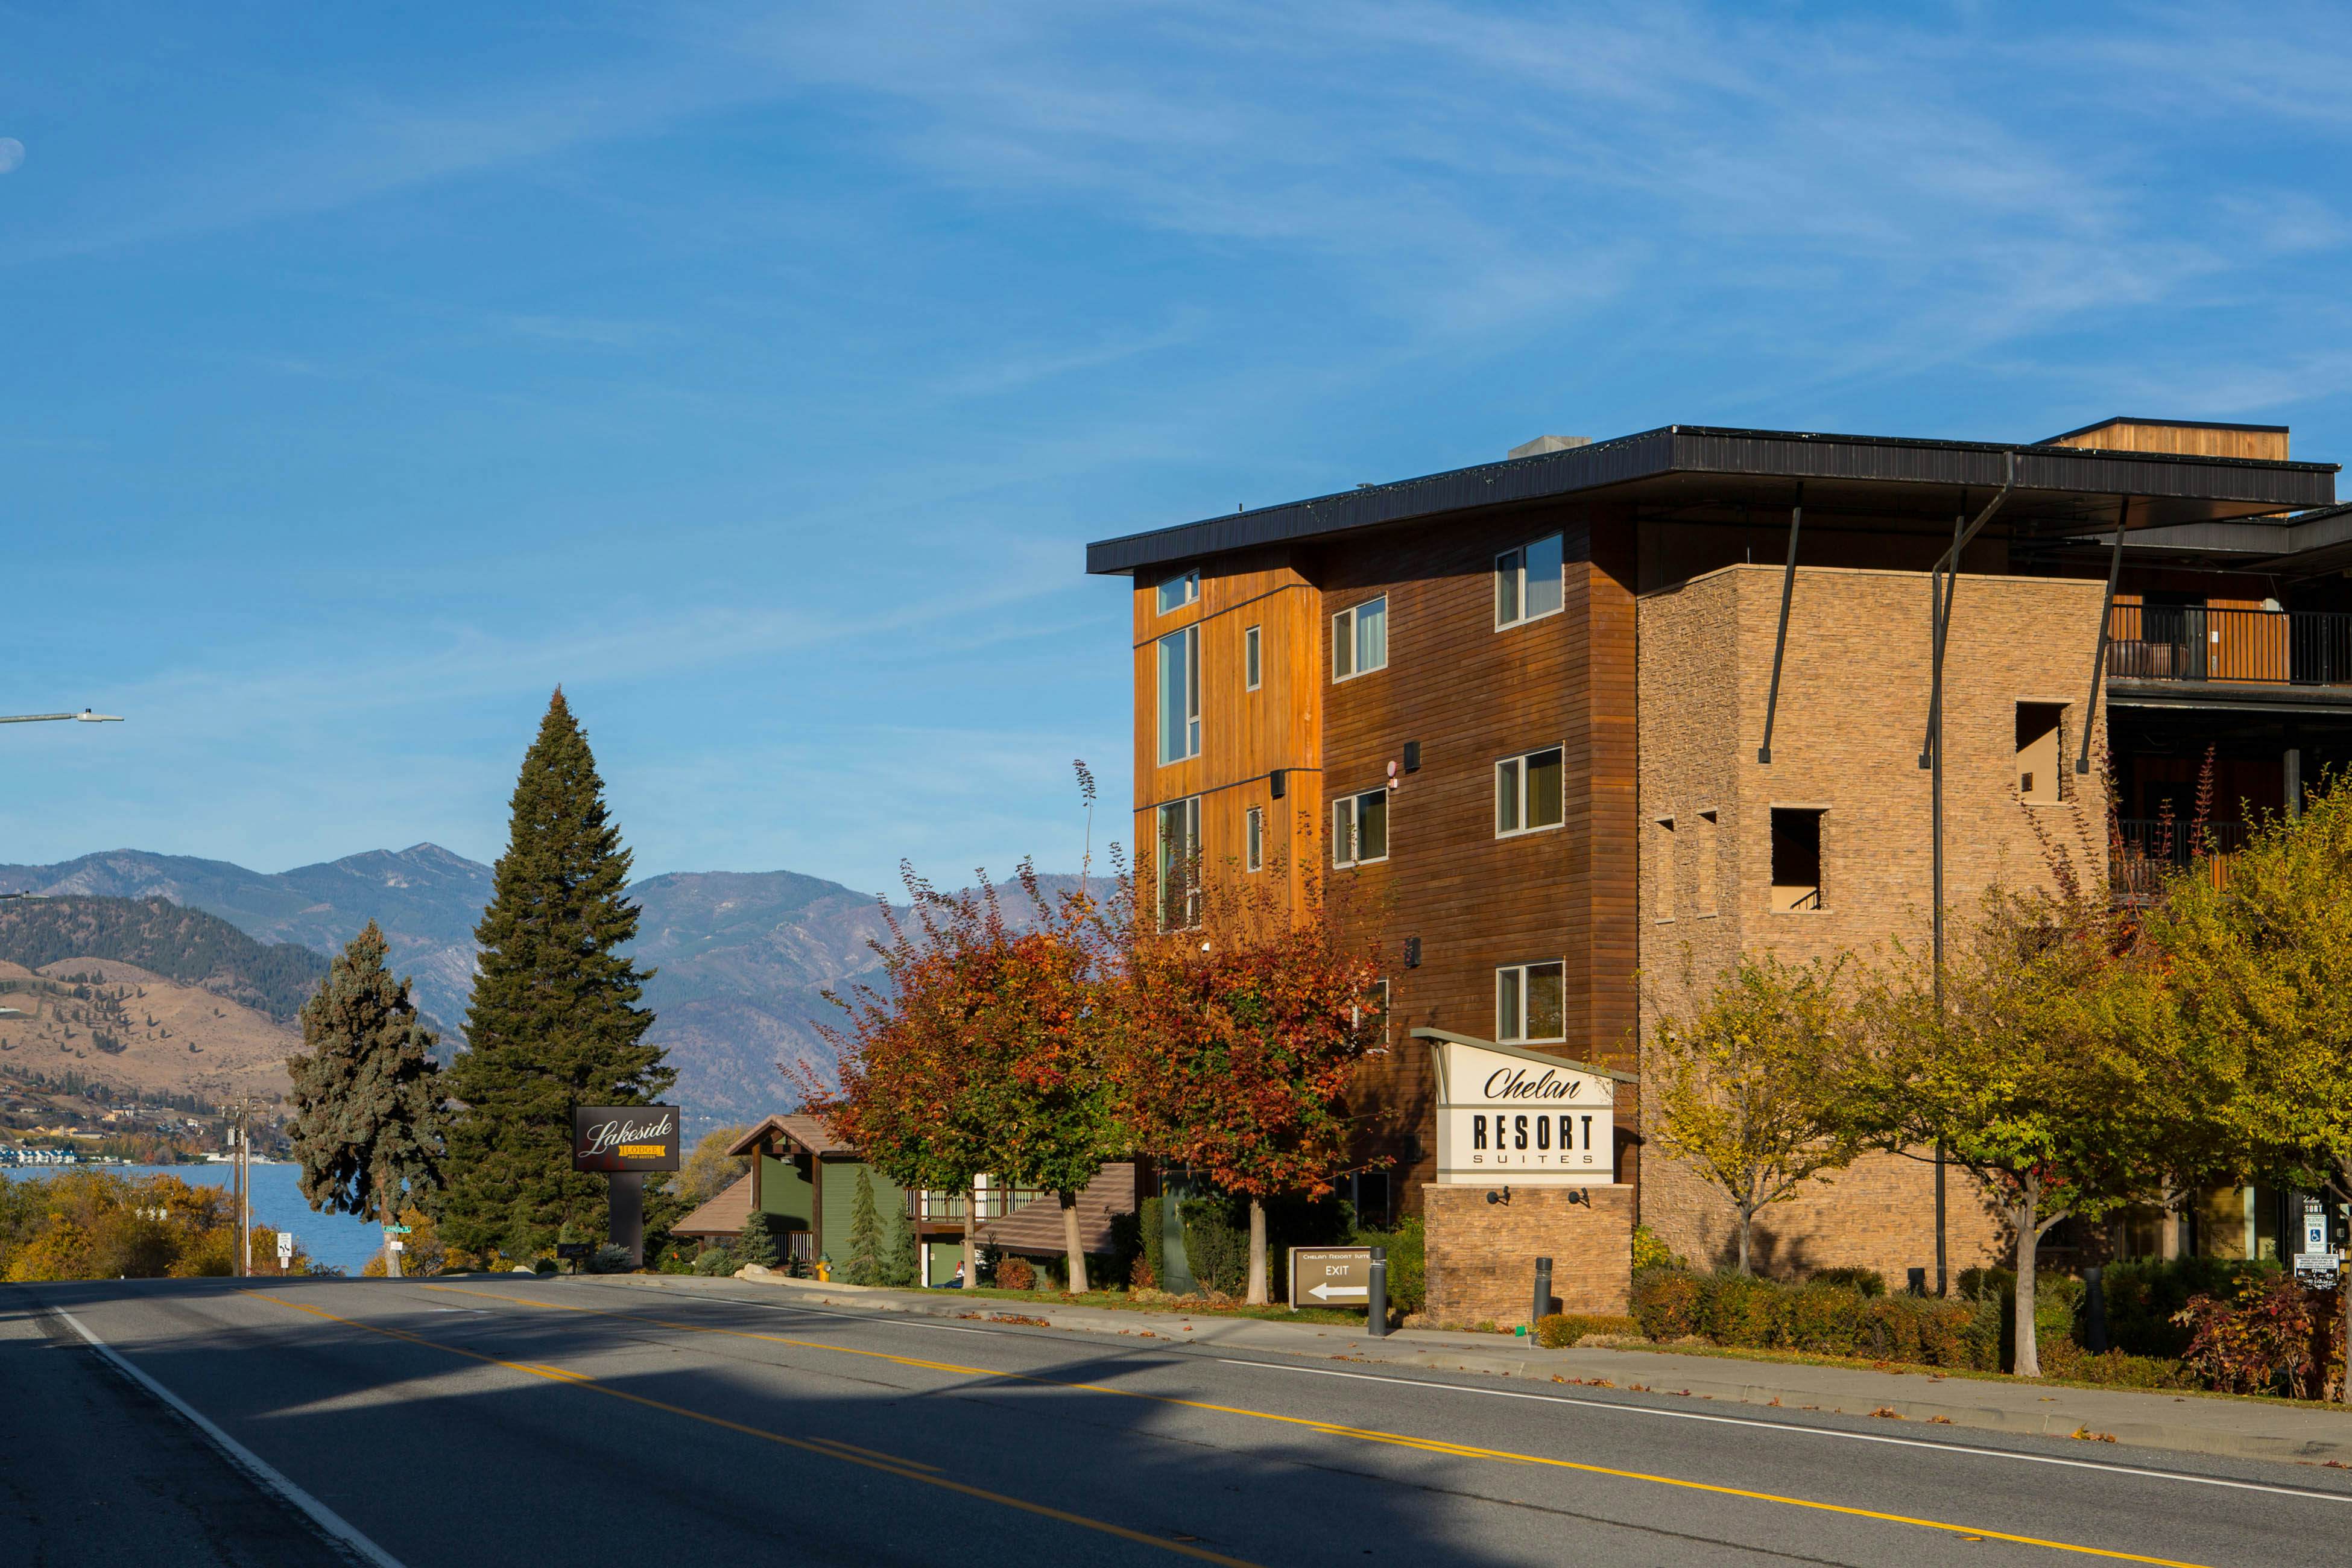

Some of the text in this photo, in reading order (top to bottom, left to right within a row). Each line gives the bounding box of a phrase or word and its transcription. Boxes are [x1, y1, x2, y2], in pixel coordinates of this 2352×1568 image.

[1484, 1067, 1581, 1099] Chelan
[578, 1114, 673, 1157] Lakeside
[1473, 1114, 1593, 1150] RESORT
[1473, 1155, 1593, 1163] SUITES
[1326, 1265, 1349, 1276] EXIT
